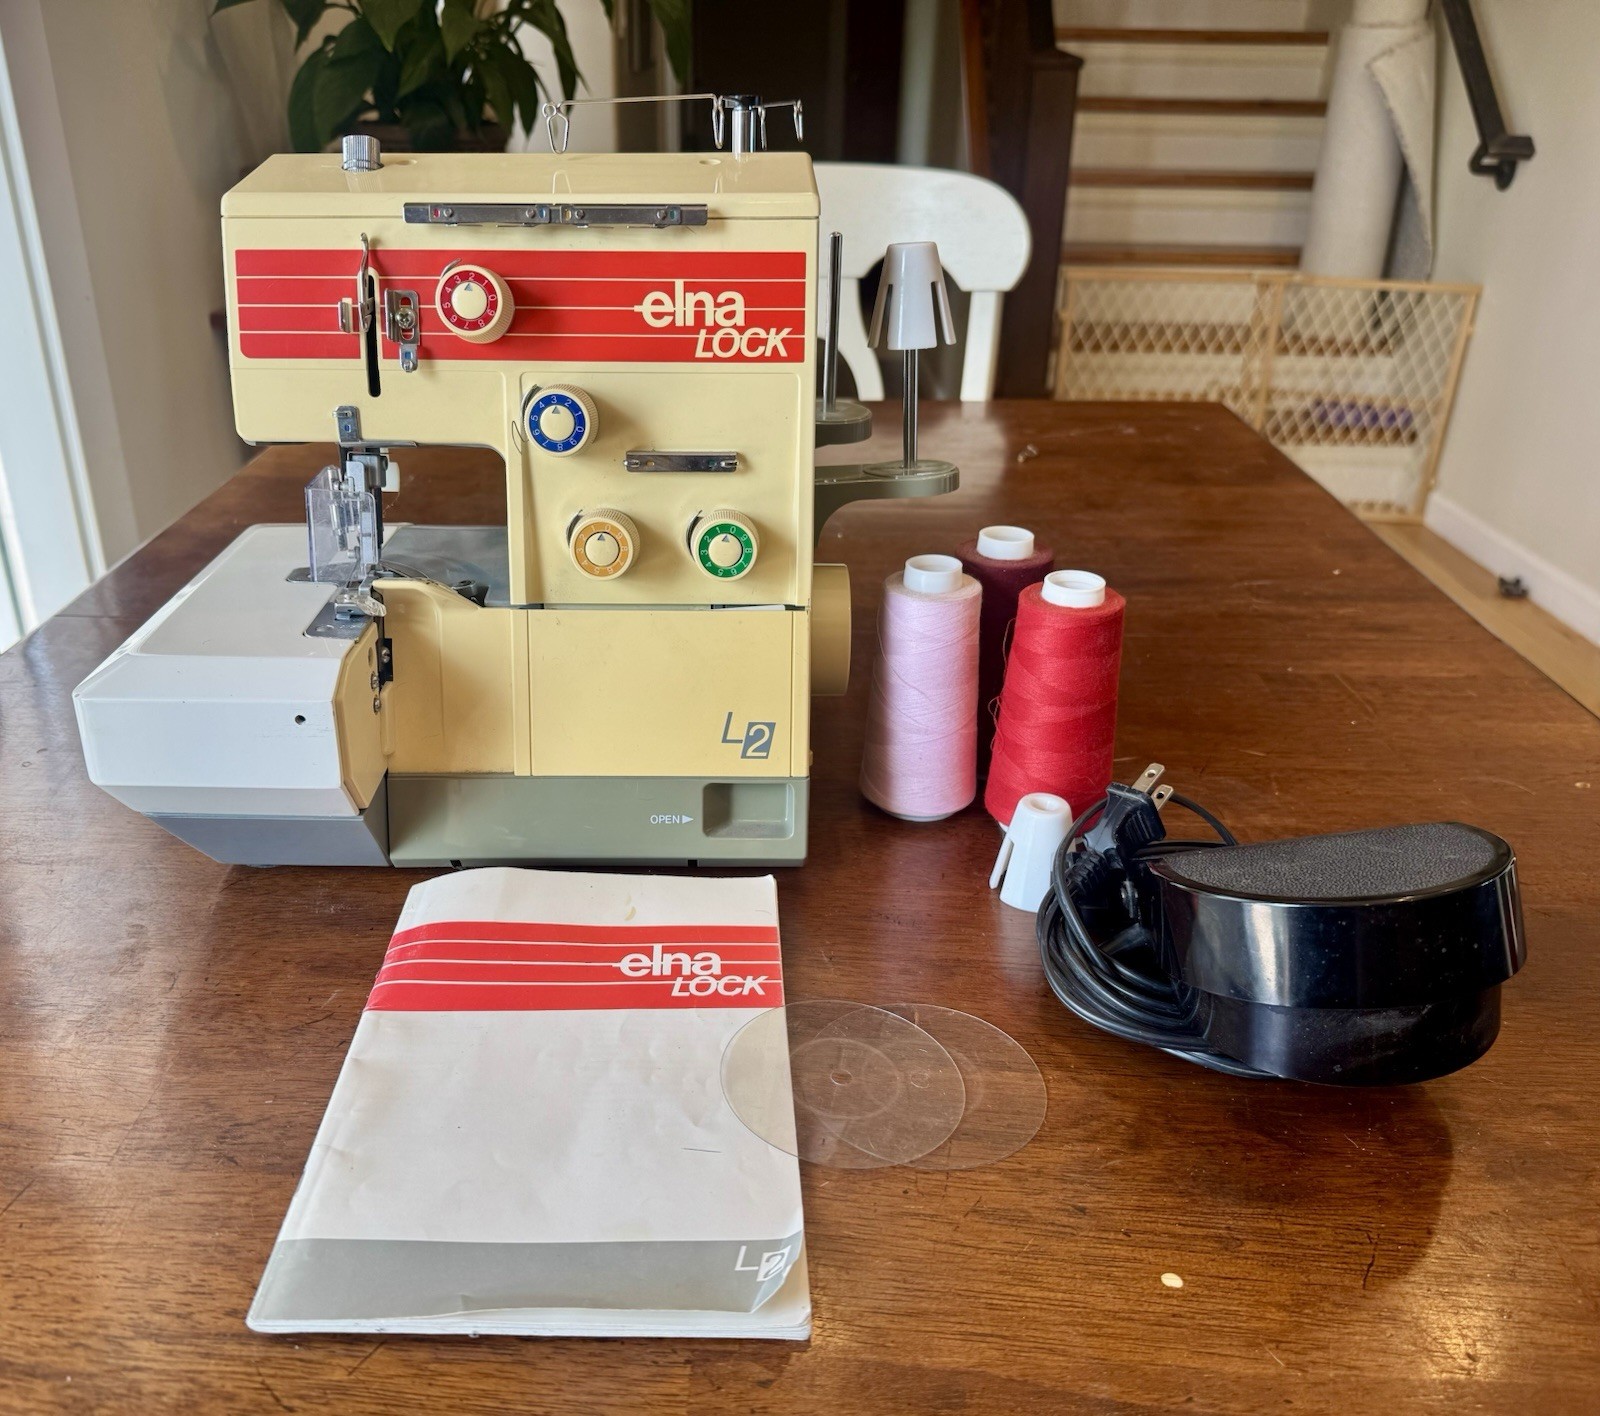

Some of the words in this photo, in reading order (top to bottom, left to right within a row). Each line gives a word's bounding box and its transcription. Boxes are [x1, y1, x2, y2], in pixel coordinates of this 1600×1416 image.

[453, 275, 461, 284] 3
[468, 272, 475, 281] 2
[442, 301, 451, 309] 5
[634, 279, 745, 328] elna
[450, 315, 457, 323] 6
[477, 319, 485, 328] 8
[463, 321, 469, 330] 7
[694, 327, 793, 358] LOCK
[551, 395, 558, 404] 3
[564, 398, 572, 407] 2
[539, 401, 545, 409] 4
[532, 428, 541, 436] 6
[569, 438, 577, 446] 9
[557, 443, 563, 451] 8
[729, 526, 736, 534] 0
[704, 535, 712, 543] 2
[717, 568, 724, 576] 5
[730, 568, 738, 576] 6
[650, 814, 680, 824] OPEN
[612, 943, 721, 977] elna
[671, 975, 769, 997] LOCK
